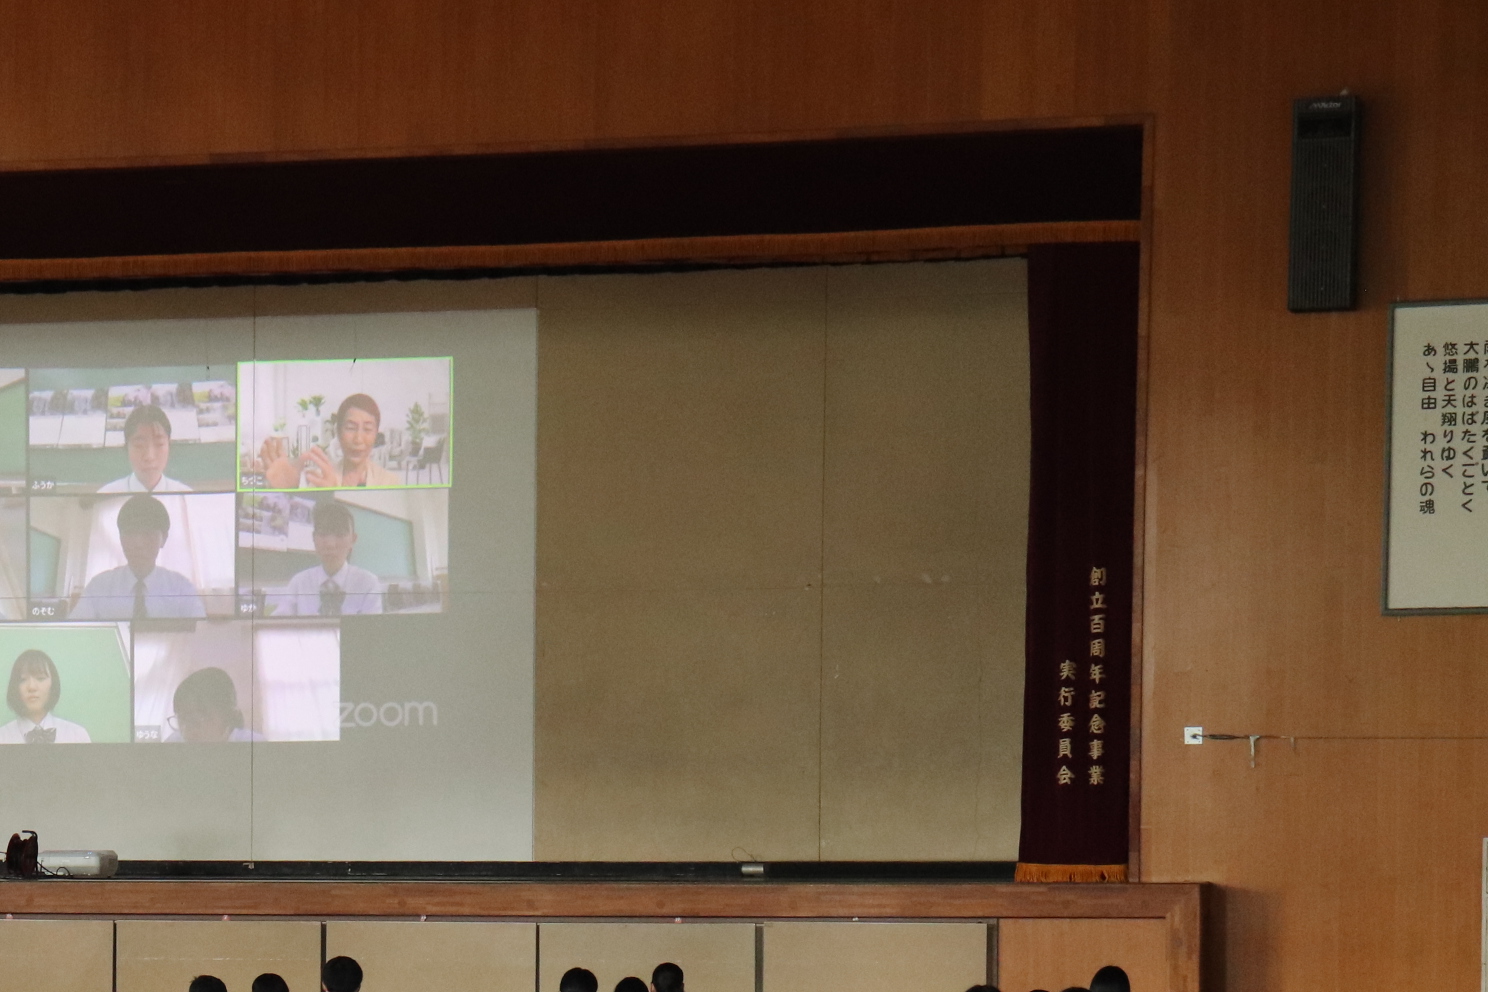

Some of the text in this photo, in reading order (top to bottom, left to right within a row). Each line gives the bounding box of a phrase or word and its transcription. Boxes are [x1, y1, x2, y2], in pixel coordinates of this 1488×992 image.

[1419, 430, 1436, 515] われらの魂
[1441, 342, 1458, 479] 悠揚と天翔りゆく
[1461, 341, 1479, 513] 大鵬のはばたくごとく
[337, 701, 438, 728] zoom
[1056, 659, 1077, 785] 実行委員会
[1088, 567, 1107, 785] 創立百周年記念事業
